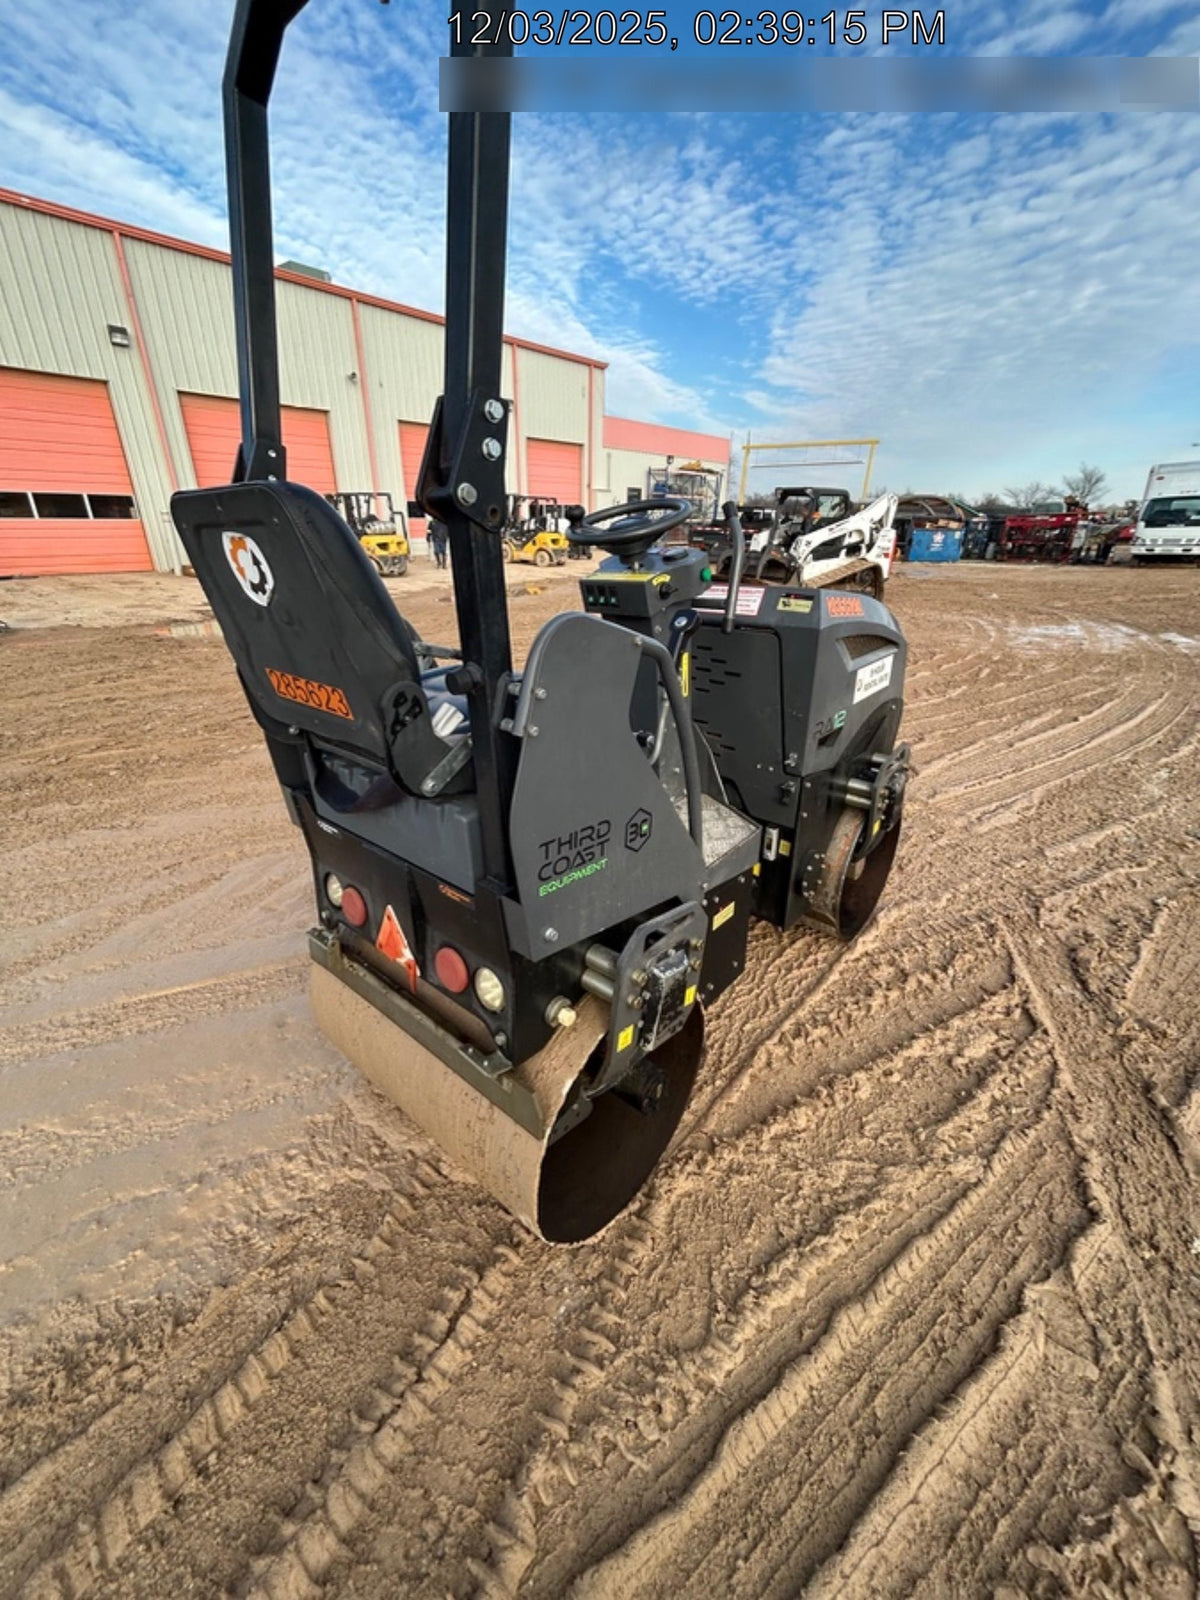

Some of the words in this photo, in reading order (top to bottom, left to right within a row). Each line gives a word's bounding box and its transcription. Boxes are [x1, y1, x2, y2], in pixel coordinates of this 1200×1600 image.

[268, 669, 350, 718] 285623
[537, 837, 611, 882] COAST
[538, 819, 612, 860] THIRD
[538, 857, 609, 897] EQUIPMENT
